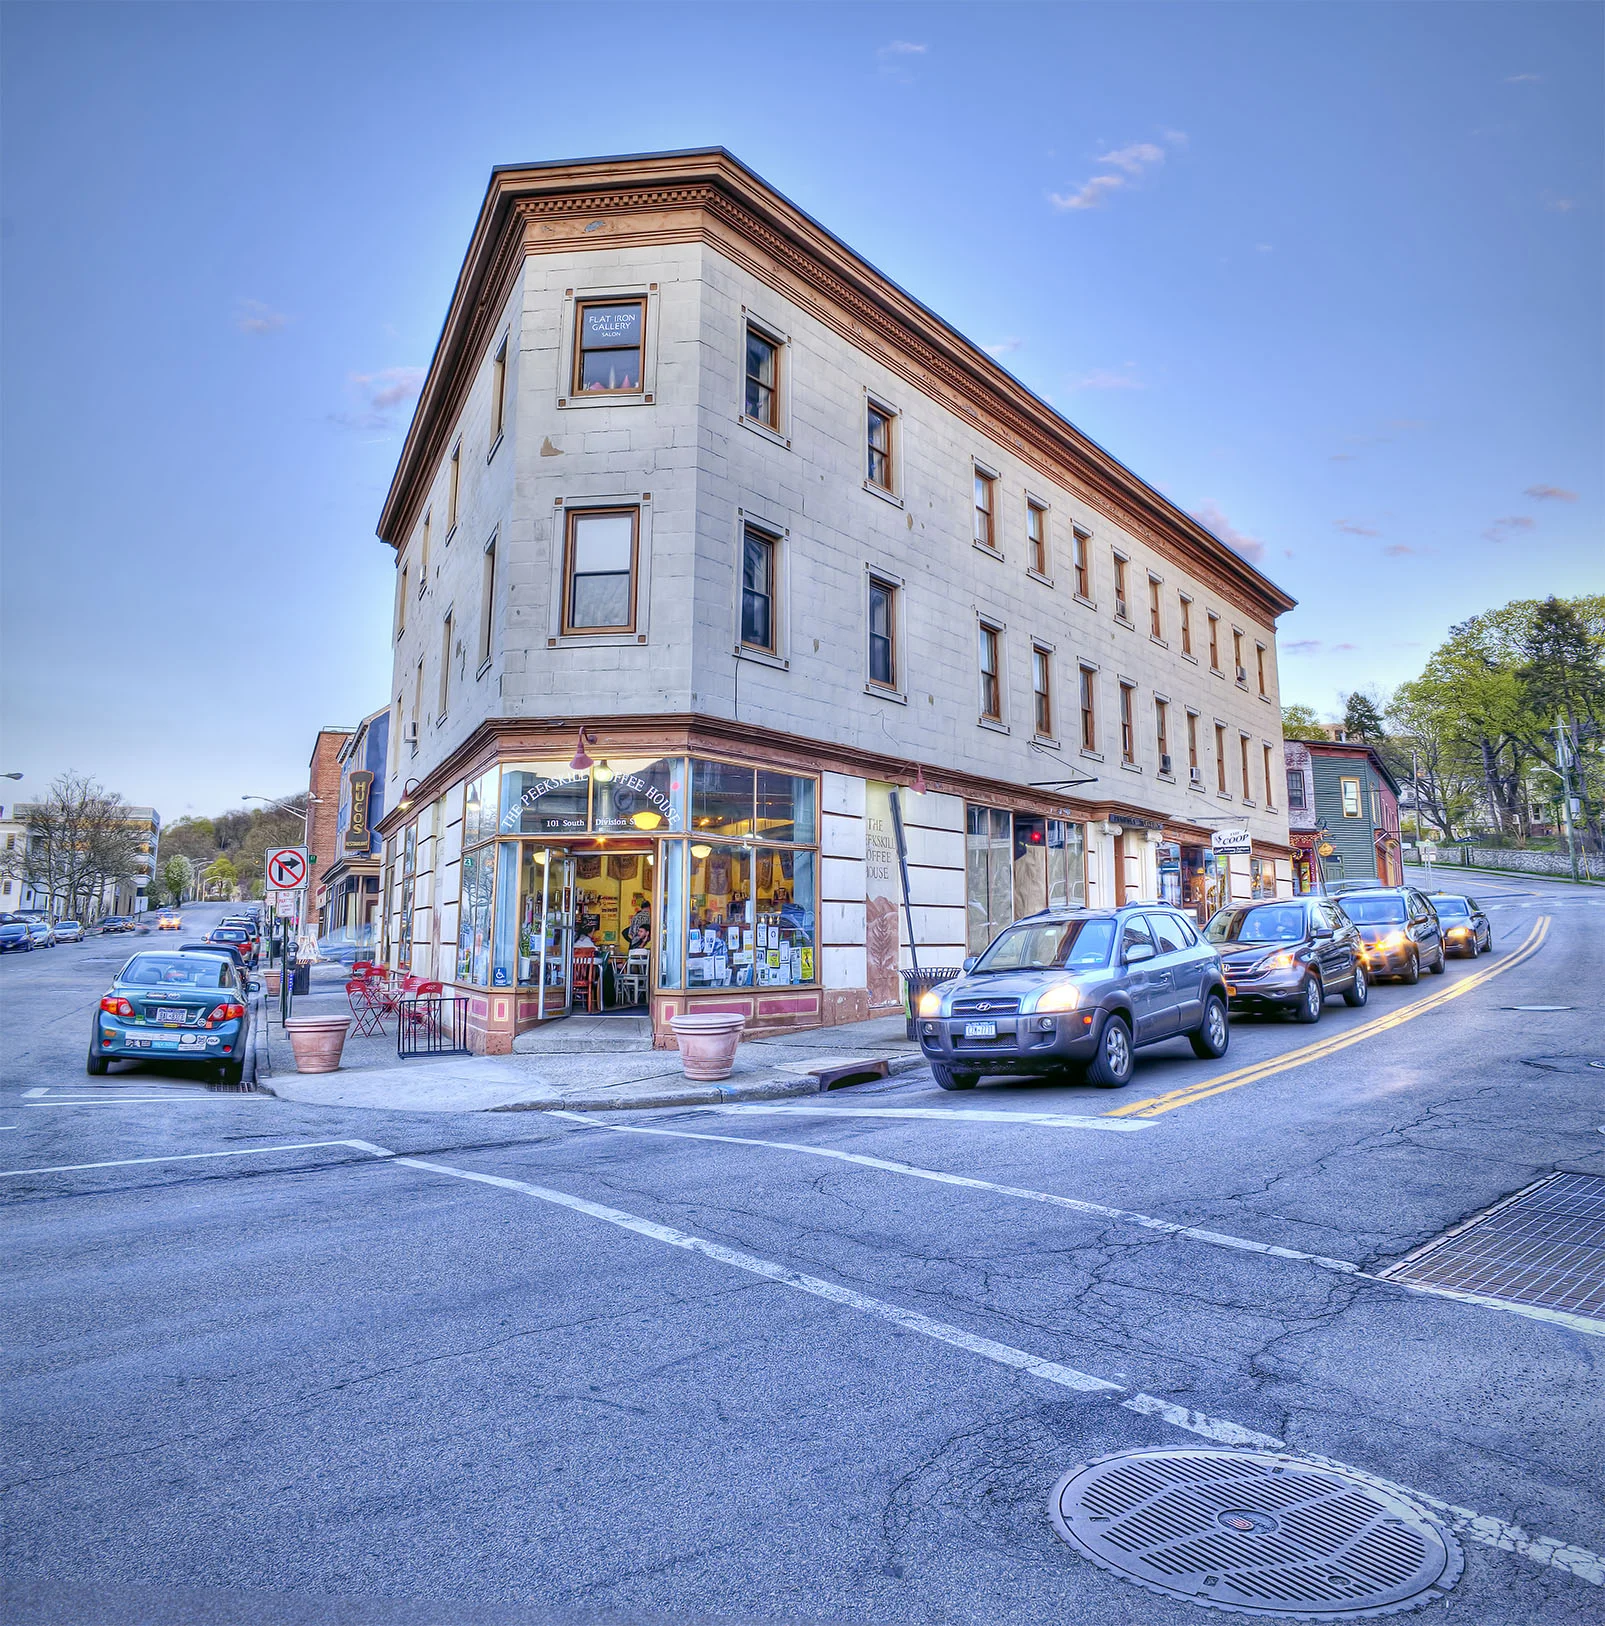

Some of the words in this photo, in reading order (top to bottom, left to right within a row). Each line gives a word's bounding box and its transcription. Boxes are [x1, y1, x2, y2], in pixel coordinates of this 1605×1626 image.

[588, 315, 611, 323] FLAT
[614, 314, 636, 322] IRON
[591, 322, 632, 331] GALLERY
[500, 803, 524, 829] THE
[644, 785, 681, 826] HOUSE
[562, 819, 585, 827] South
[595, 818, 627, 826] Division
[868, 818, 883, 832] THE
[866, 849, 891, 863] OFFEE
